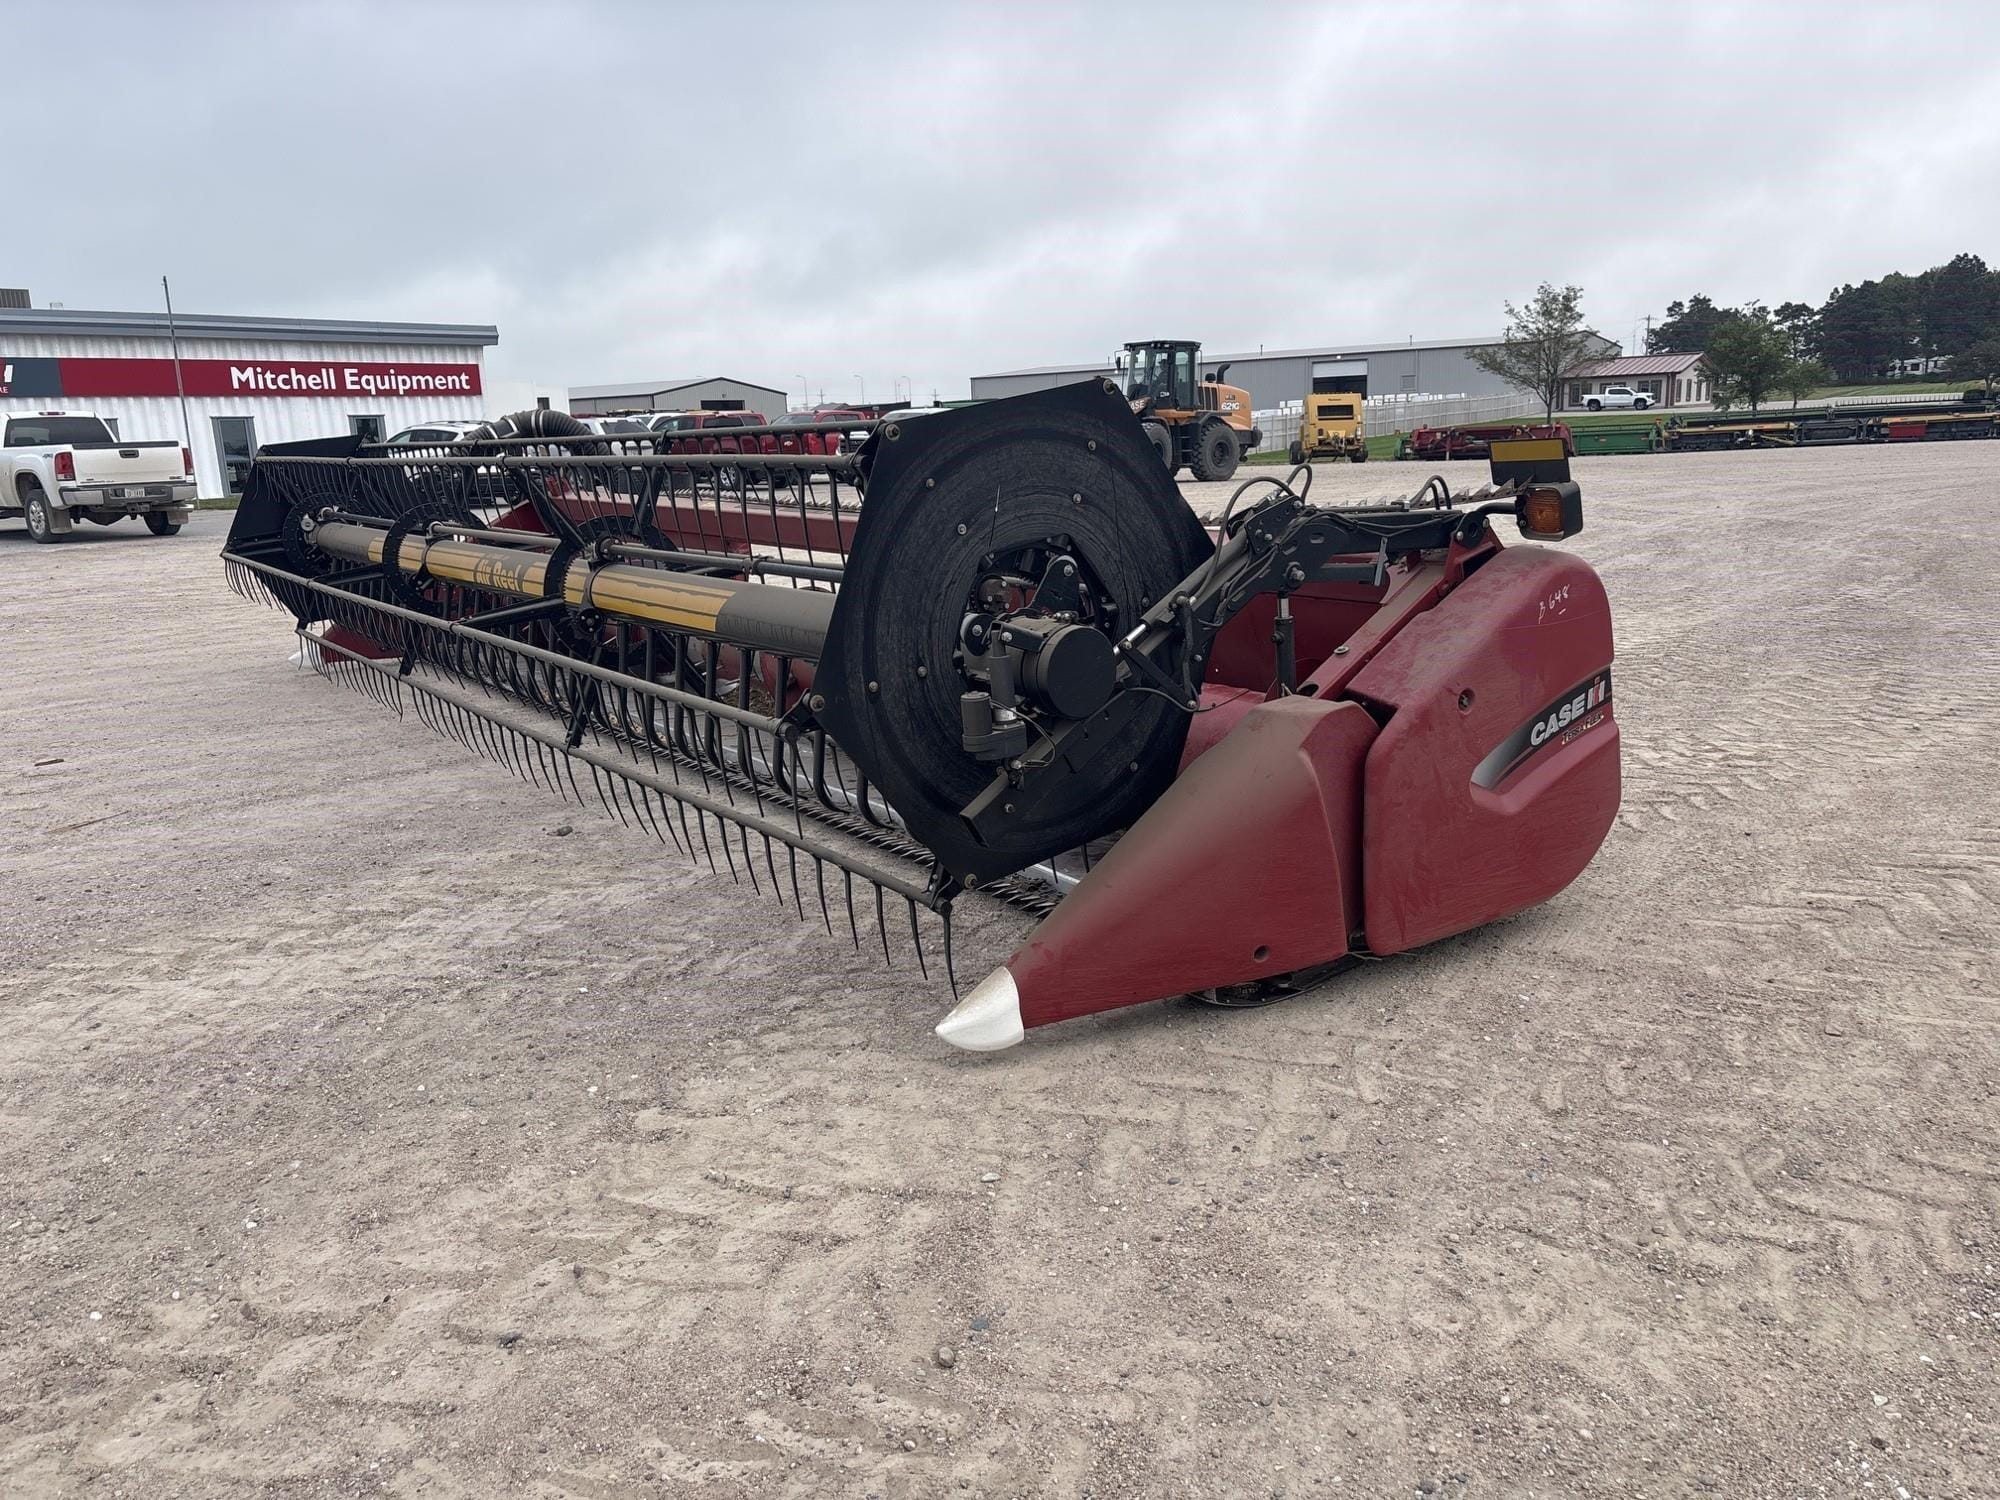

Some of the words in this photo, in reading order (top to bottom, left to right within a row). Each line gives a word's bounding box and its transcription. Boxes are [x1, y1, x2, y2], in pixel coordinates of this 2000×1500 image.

[230, 366, 336, 390] Mitchell
[343, 368, 470, 395] Equipment
[1530, 693, 1586, 746] CASE
